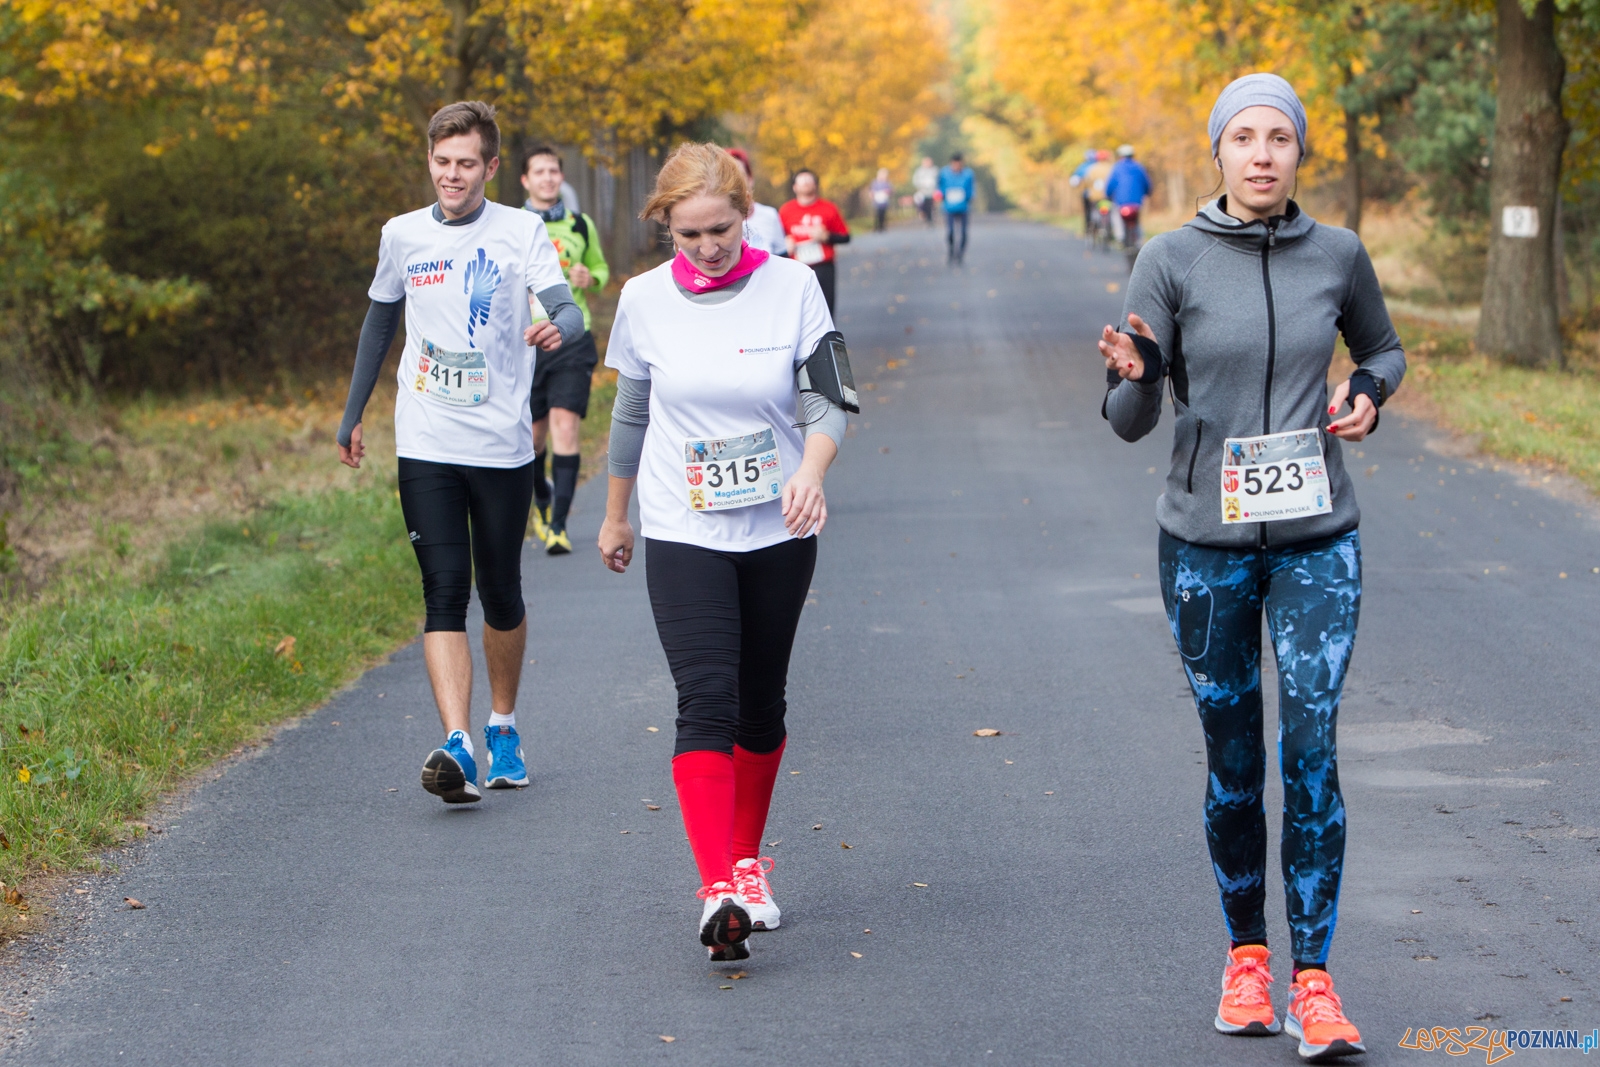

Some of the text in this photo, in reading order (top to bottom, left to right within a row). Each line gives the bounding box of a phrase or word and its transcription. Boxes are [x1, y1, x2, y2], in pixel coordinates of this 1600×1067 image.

[407, 259, 454, 275] HERNIK
[411, 273, 445, 288] TEAM
[771, 344, 792, 352] POLSKA
[430, 364, 463, 388] 411
[438, 386, 451, 395] Filip
[706, 457, 760, 488] 315
[1244, 462, 1304, 496] 523
[714, 486, 756, 499] Magdalena
[713, 494, 765, 507] POLINOVA POLSKA
[1250, 505, 1311, 517] POLINOVA POLSKA
